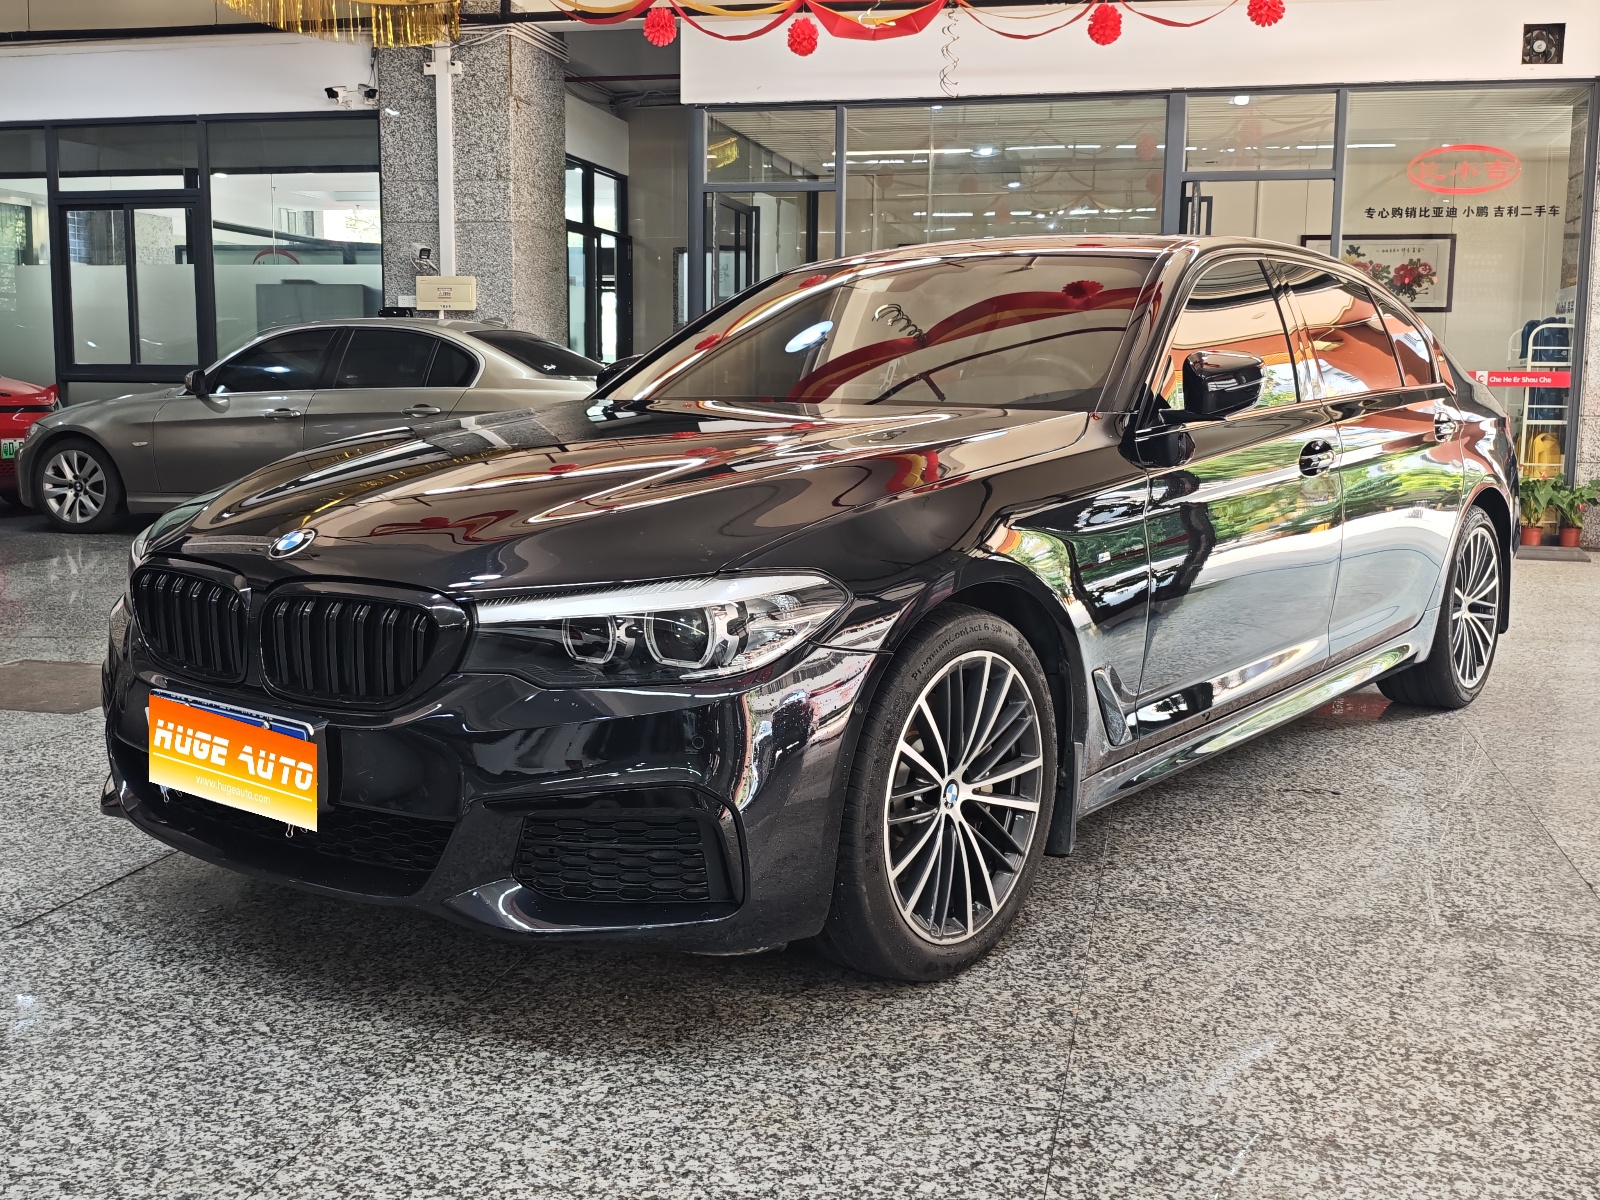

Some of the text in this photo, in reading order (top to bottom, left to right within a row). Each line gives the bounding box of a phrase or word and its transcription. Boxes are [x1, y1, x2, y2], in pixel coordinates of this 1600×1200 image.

[1364, 205, 1560, 219] 专心购销比亚迪 小鹏 吉利二手车
